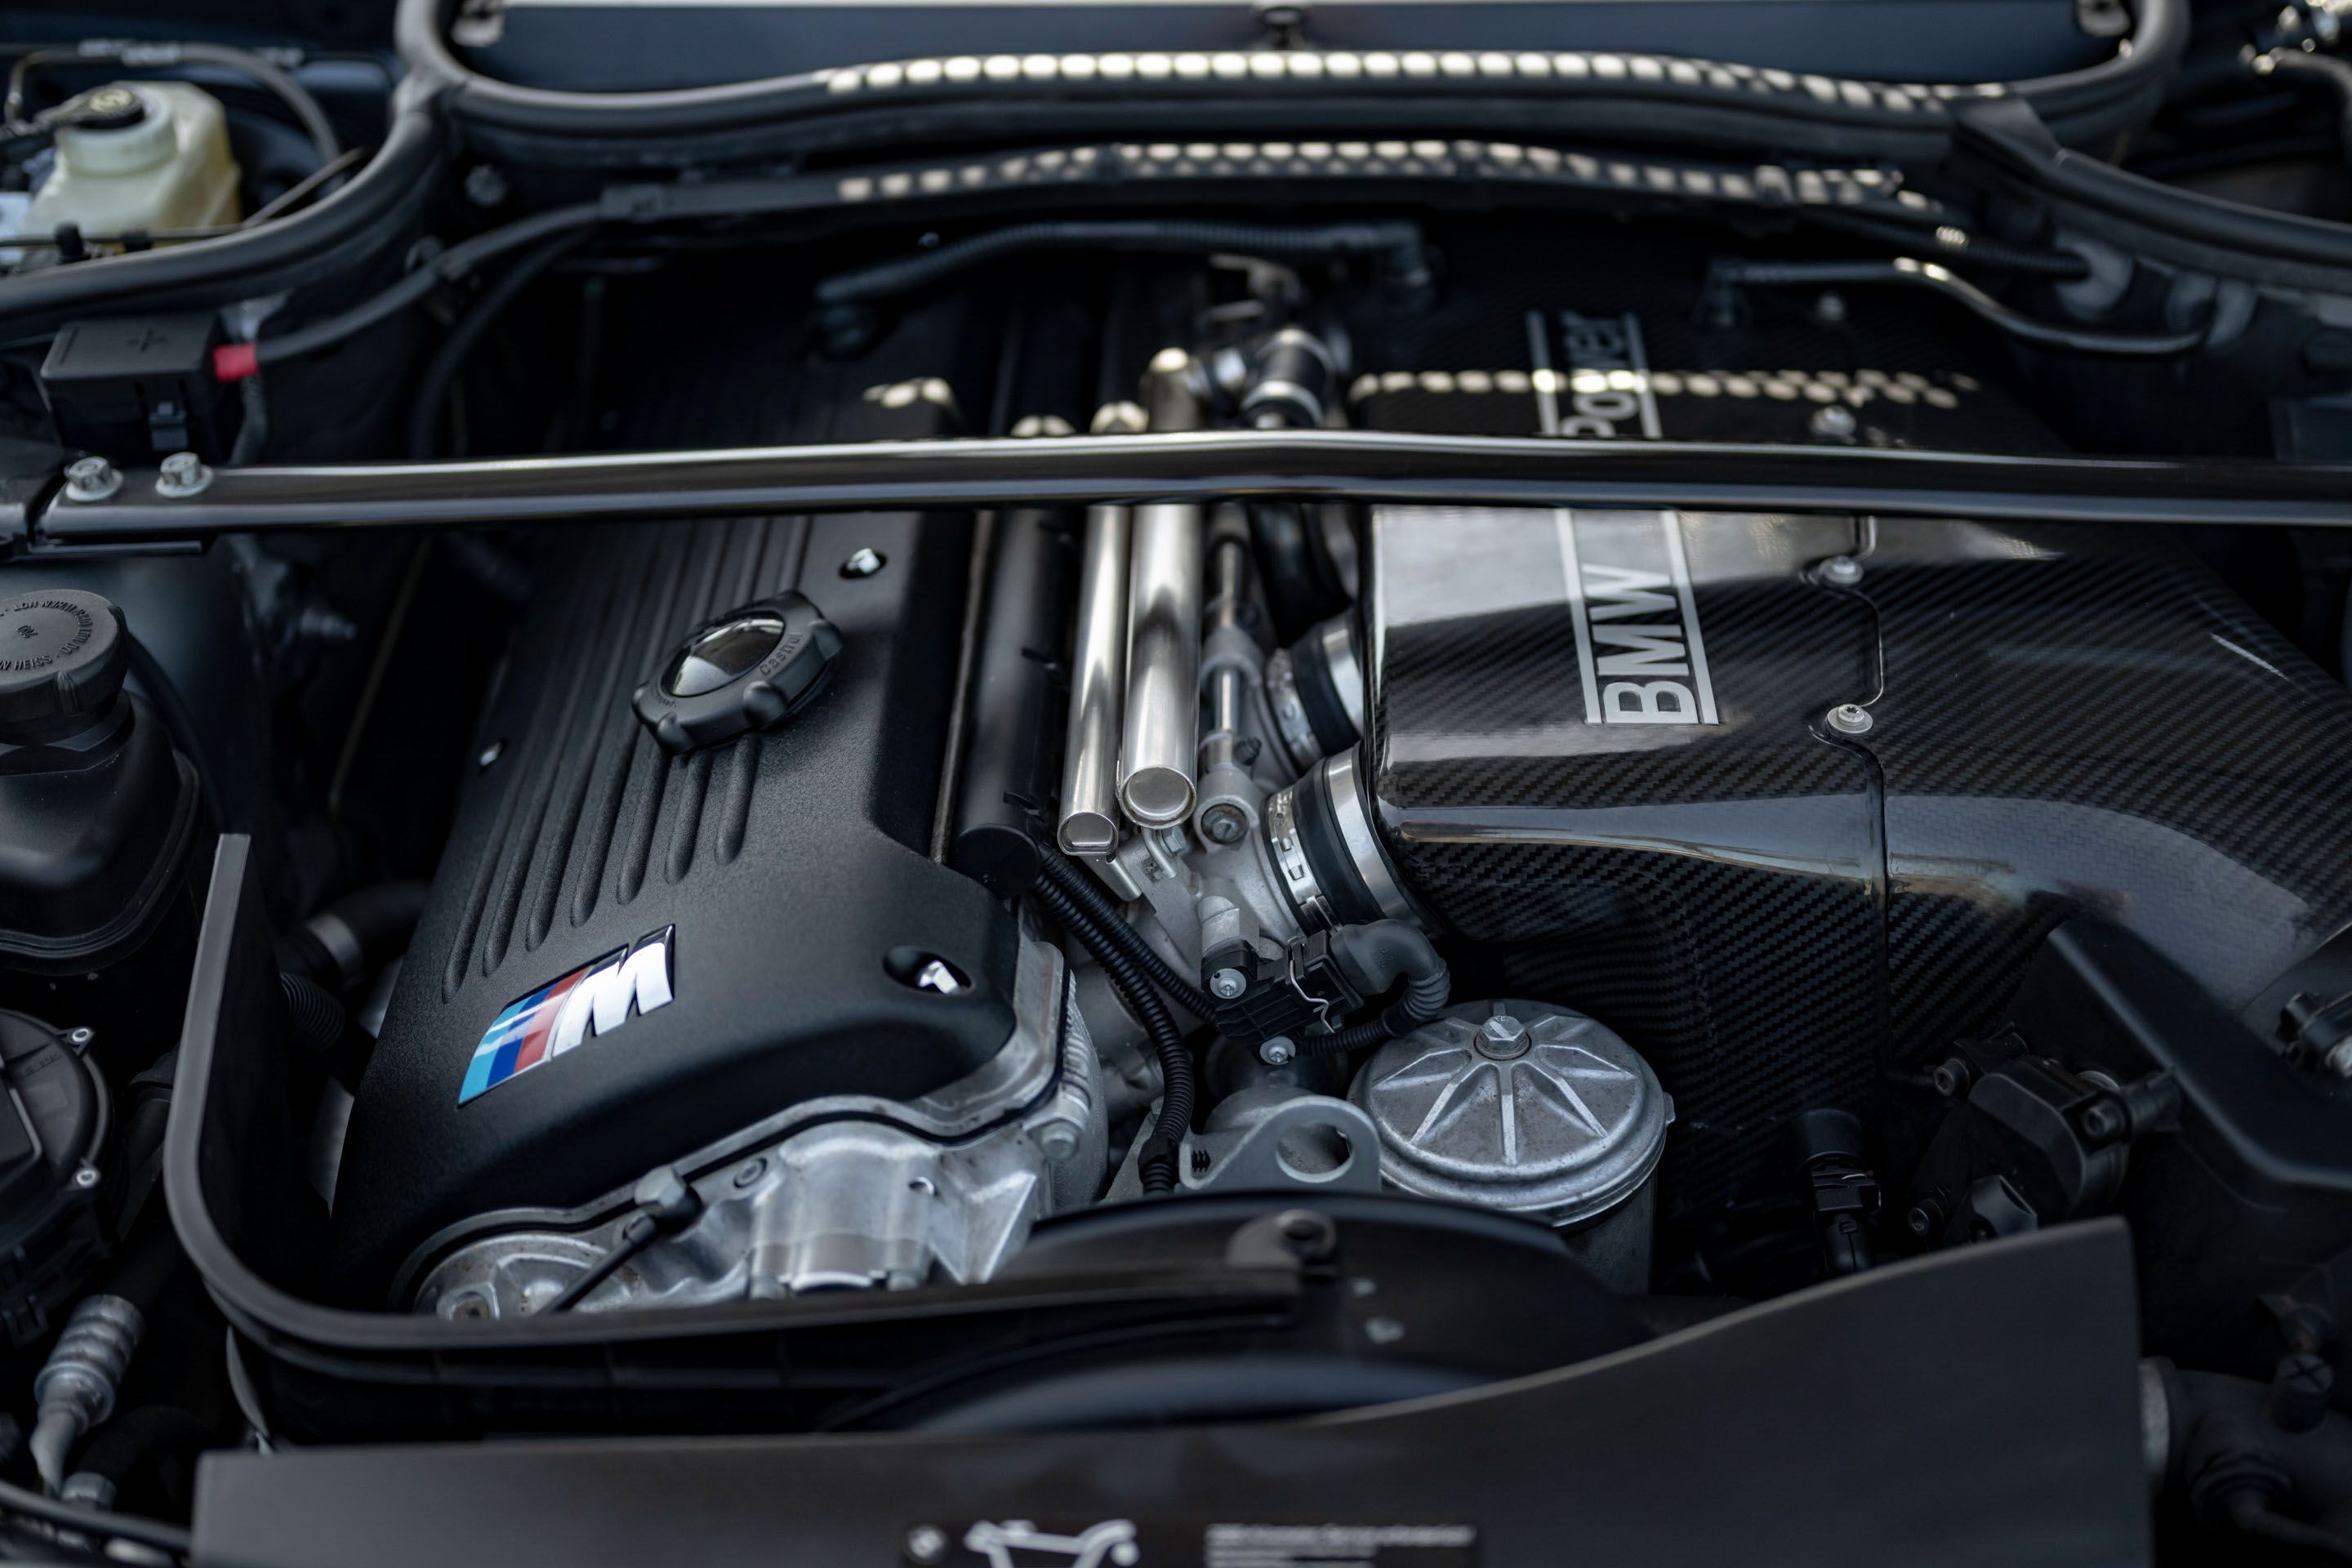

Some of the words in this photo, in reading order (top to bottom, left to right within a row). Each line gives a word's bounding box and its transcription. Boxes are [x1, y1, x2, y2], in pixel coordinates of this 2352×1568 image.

[14, 655, 53, 670] HEISS
[1582, 563, 1699, 724] BMW
[551, 923, 675, 1058] M
